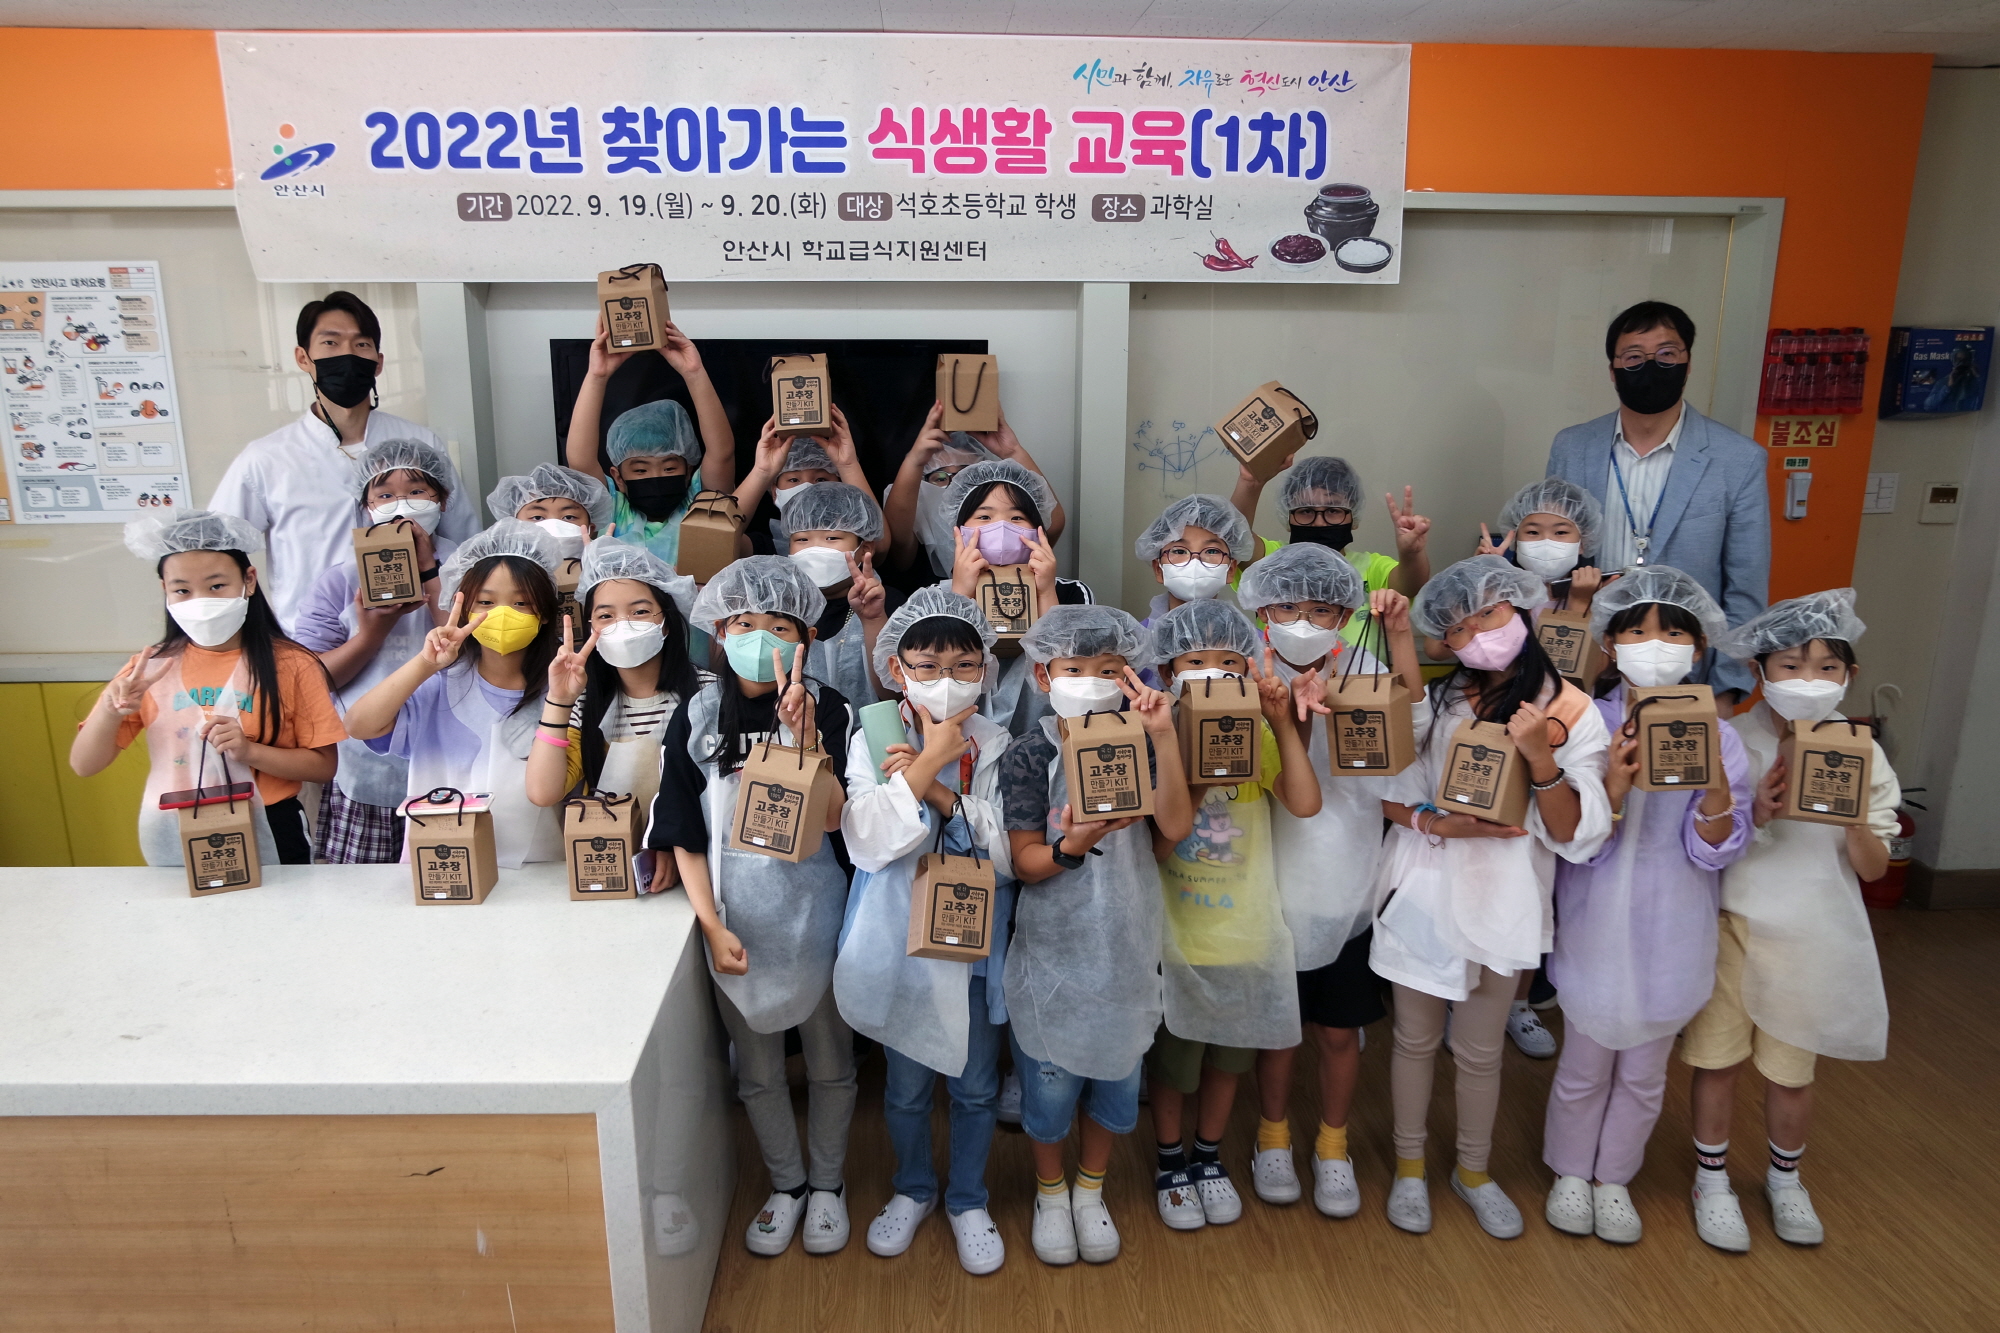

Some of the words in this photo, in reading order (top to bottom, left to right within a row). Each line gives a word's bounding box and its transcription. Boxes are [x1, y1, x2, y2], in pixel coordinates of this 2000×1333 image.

[1073, 58, 1132, 94] 시민과
[1178, 69, 1235, 98] 자유로운
[1239, 69, 1302, 97] 혁신도시
[1308, 69, 1358, 93] 안산
[365, 106, 584, 174] 2022년
[601, 106, 848, 176] 찾아가는
[867, 106, 1053, 176] 식생활
[1068, 107, 1328, 180] 교육(1차)
[273, 184, 326, 197] 안산시
[466, 195, 504, 219] 기간
[845, 195, 884, 219] 대상
[896, 192, 1027, 220] 석호초등학교
[1034, 192, 1078, 220] 학생
[1101, 196, 1139, 219] 장소
[1150, 193, 1214, 221] 과학실
[722, 240, 792, 262] 안산시
[802, 239, 987, 262] 학교급식지원센터
[31, 278, 67, 289] 안전사고
[615, 311, 642, 321] 고추장
[1913, 352, 1928, 361] Gas
[1929, 351, 1950, 360] Mask
[786, 390, 814, 399] 고추장
[1251, 428, 1262, 438] KIT
[1771, 421, 1836, 447] 불조심
[373, 563, 403, 574] 고추장
[1344, 727, 1377, 738] 고추장
[1209, 734, 1244, 745] 고추장
[1659, 740, 1698, 751] 고추장
[1090, 763, 1127, 777] 고추장
[1459, 760, 1493, 776] 고추장
[1476, 776, 1490, 786] KIT
[1812, 768, 1852, 783] 고추장
[1114, 778, 1128, 786] KIT
[755, 800, 791, 819] 고추장
[775, 819, 789, 829] KIT
[201, 848, 236, 860] 고추장
[584, 853, 617, 863] 고추장
[428, 861, 461, 871] 고추장
[1181, 886, 1234, 908] FILA
[943, 900, 978, 915] 고추장
[964, 916, 977, 925] KIT
